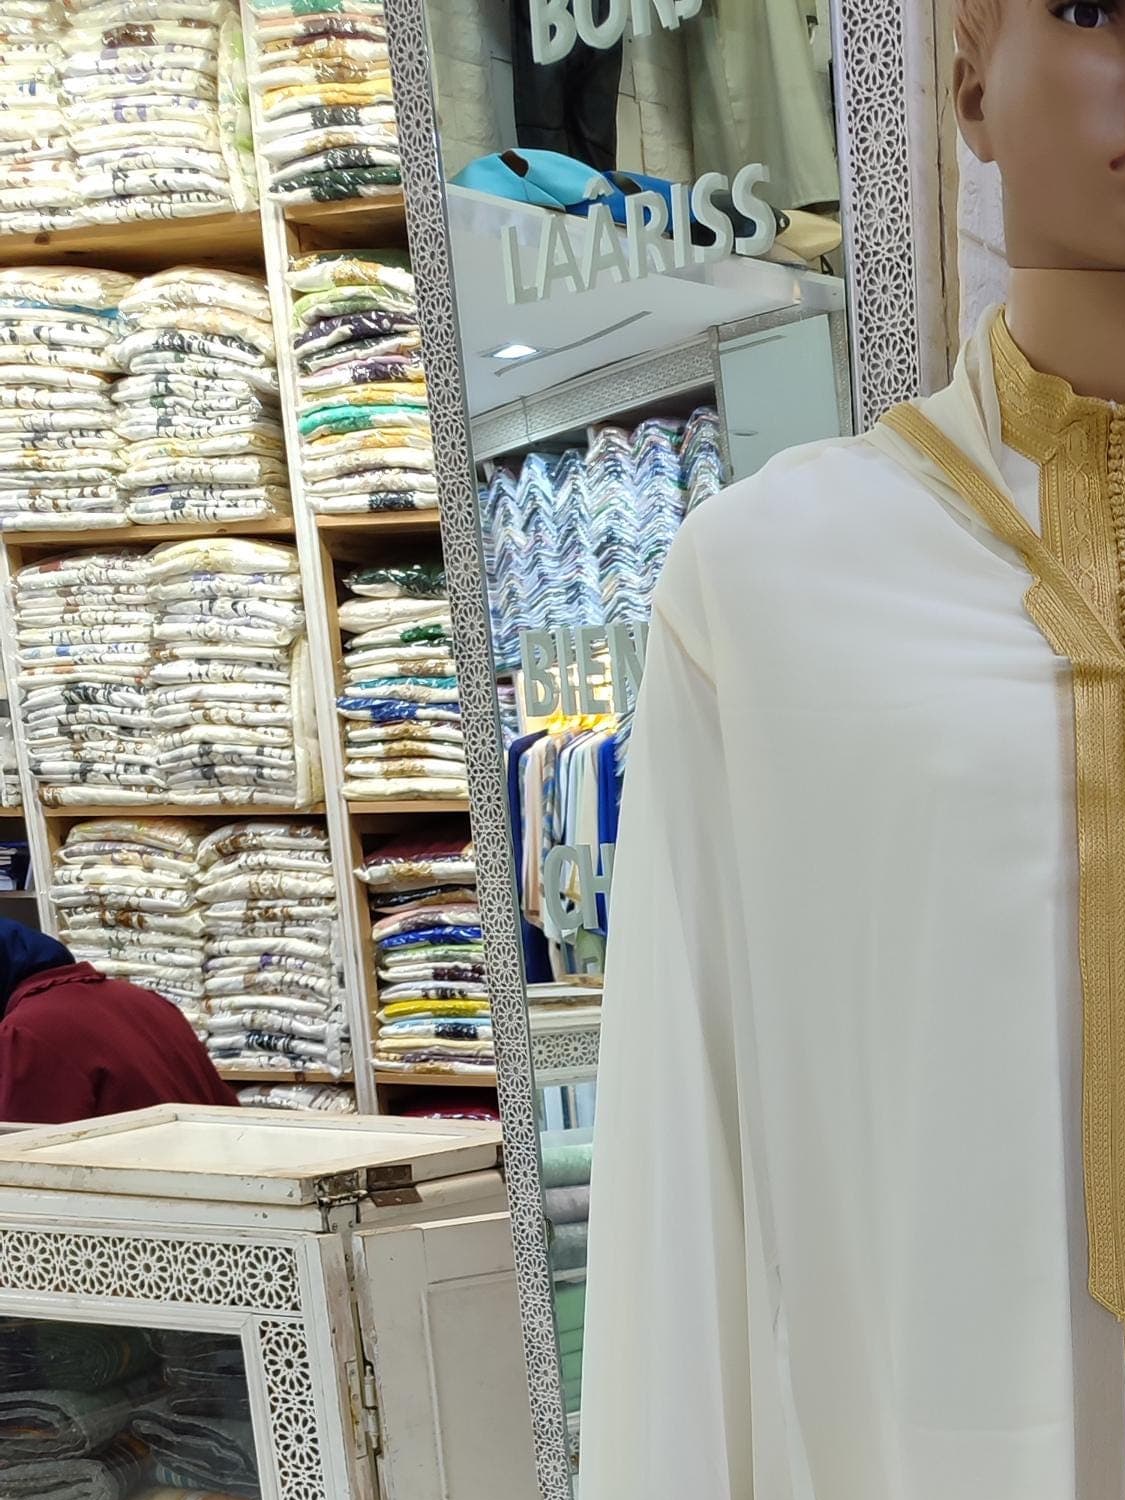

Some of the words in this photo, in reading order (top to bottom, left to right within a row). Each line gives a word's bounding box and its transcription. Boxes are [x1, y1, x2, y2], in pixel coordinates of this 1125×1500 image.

[502, 162, 777, 305] LAÂRISS
[519, 621, 650, 718] BIEN
[544, 842, 616, 931] CH
